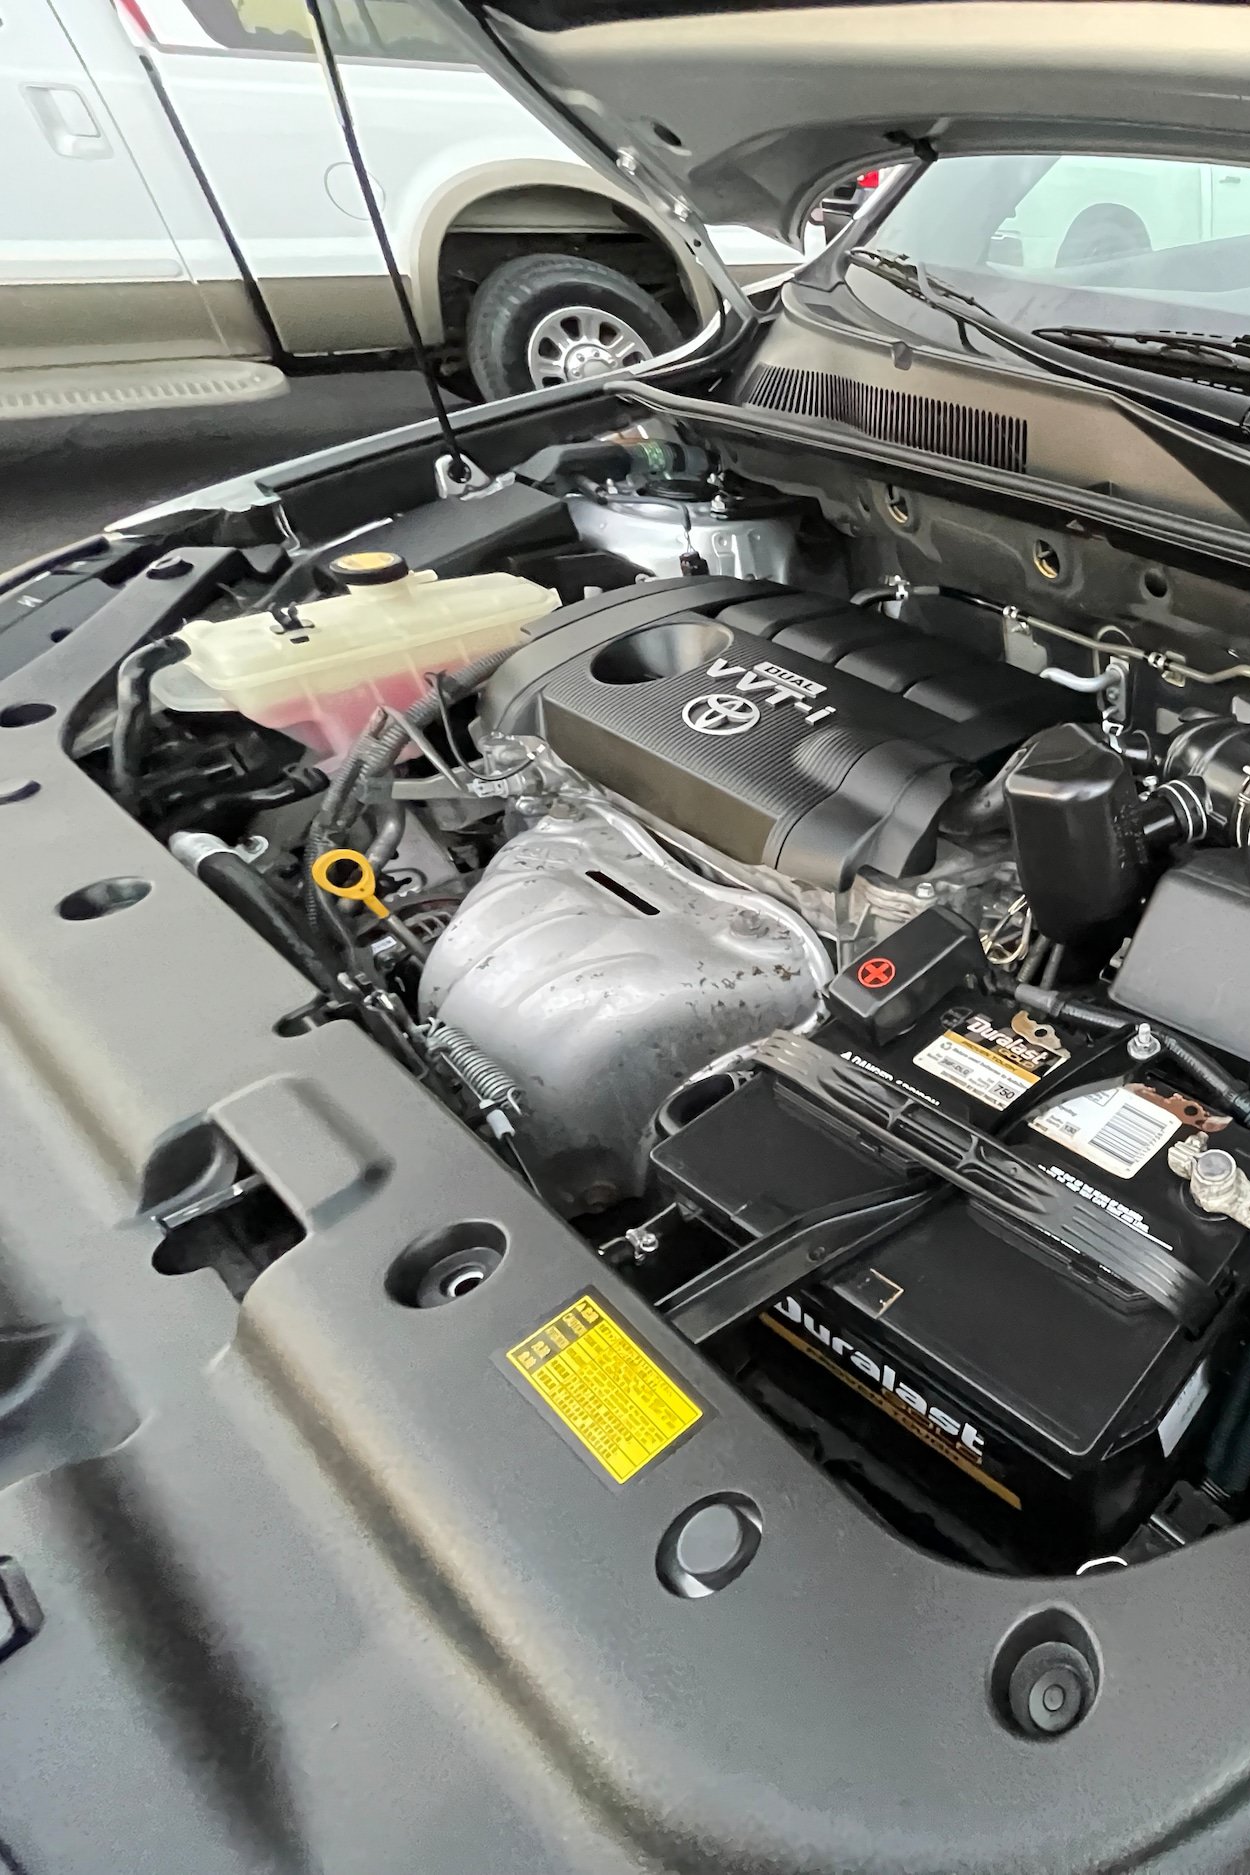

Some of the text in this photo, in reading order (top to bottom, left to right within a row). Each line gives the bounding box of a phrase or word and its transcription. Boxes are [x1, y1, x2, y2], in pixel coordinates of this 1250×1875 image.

[706, 658, 837, 725] VVT-i
[764, 666, 815, 692] DUAL
[965, 1013, 1050, 1066] Duralast
[999, 1048, 1038, 1070] GOLD
[993, 1083, 1015, 1100] 750
[774, 1296, 984, 1456] Duralast
